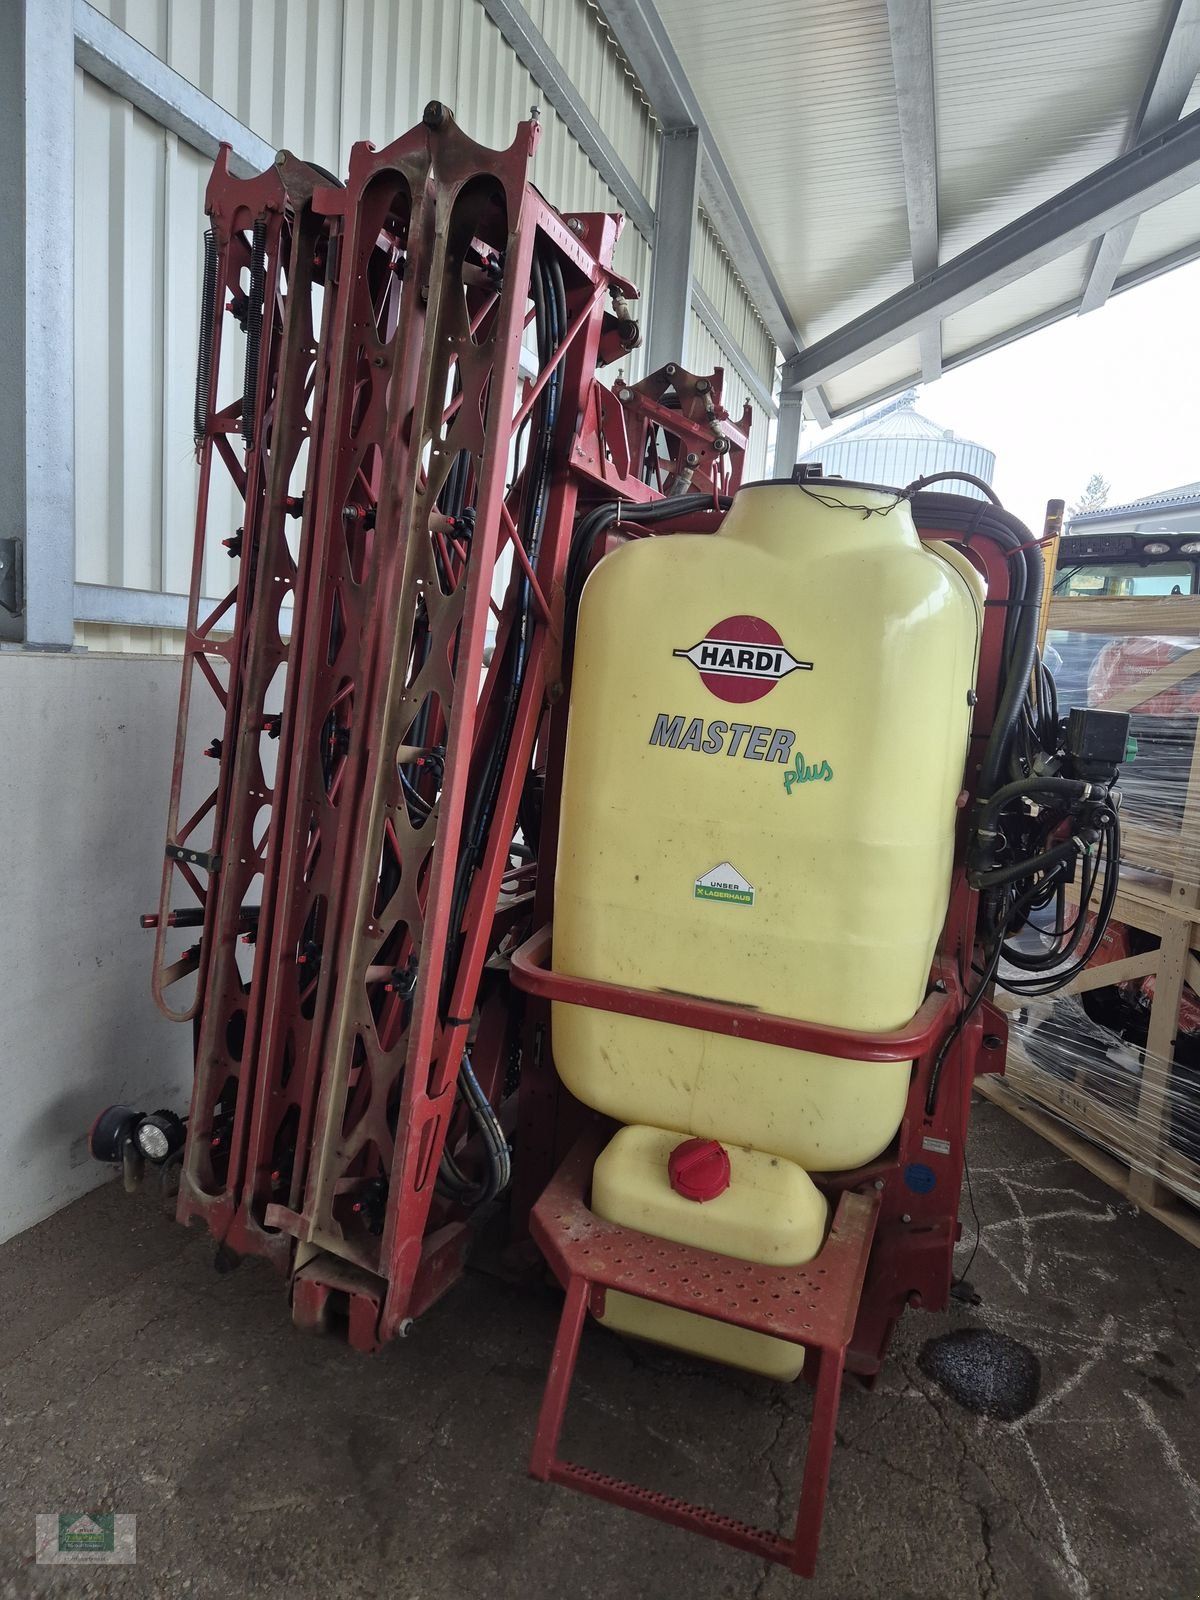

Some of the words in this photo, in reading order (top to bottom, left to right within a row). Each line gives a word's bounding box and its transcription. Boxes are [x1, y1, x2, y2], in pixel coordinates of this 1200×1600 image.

[701, 646, 782, 673] HARDI
[649, 713, 796, 764] MASTER
[783, 751, 833, 795] plus
[704, 890, 751, 902] LAGERHAUS
[710, 881, 739, 890] UNSER
